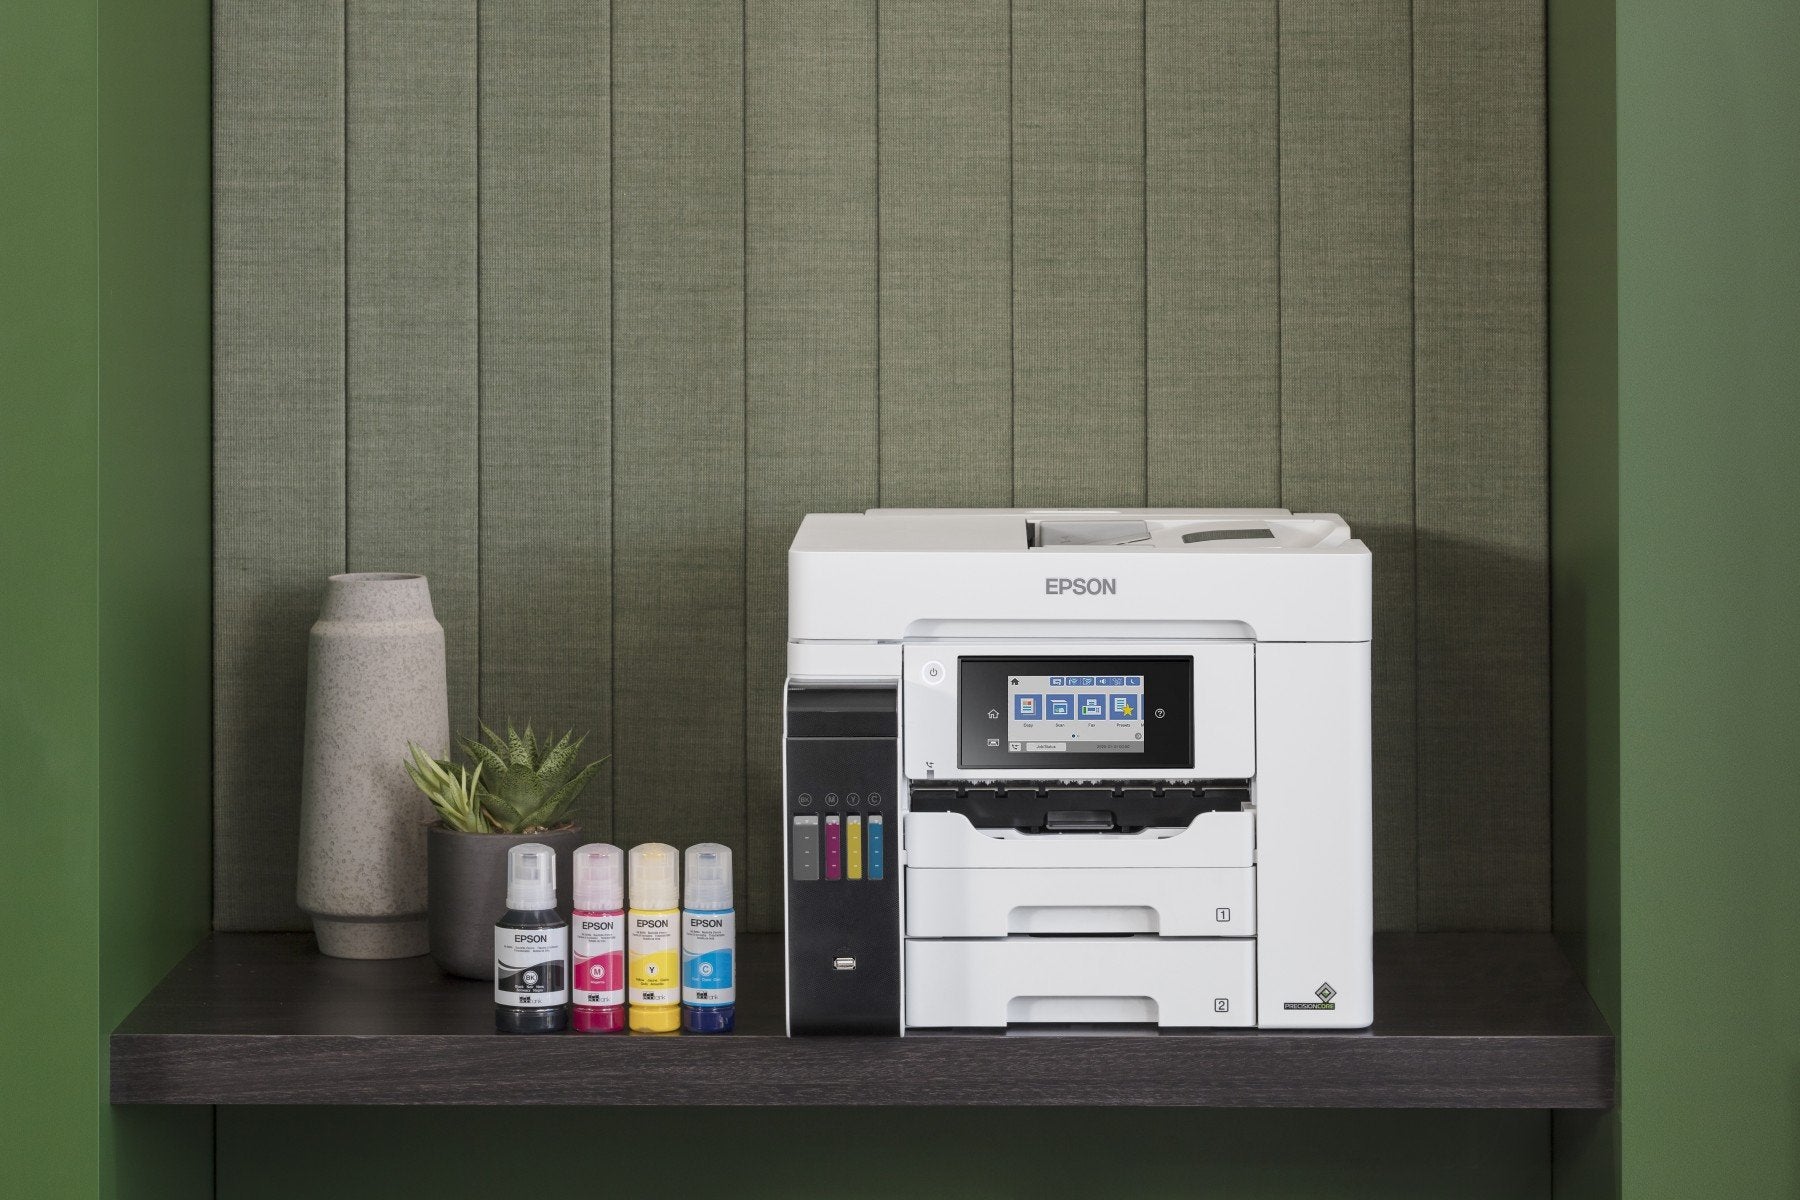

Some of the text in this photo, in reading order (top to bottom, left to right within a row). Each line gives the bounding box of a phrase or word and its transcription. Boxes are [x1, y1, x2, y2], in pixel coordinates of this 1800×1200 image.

[1045, 578, 1116, 595] EPSON
[582, 921, 614, 930] EPSON
[636, 920, 669, 928] EPSON
[691, 919, 723, 927] EPSON
[514, 935, 547, 943] EPSON
